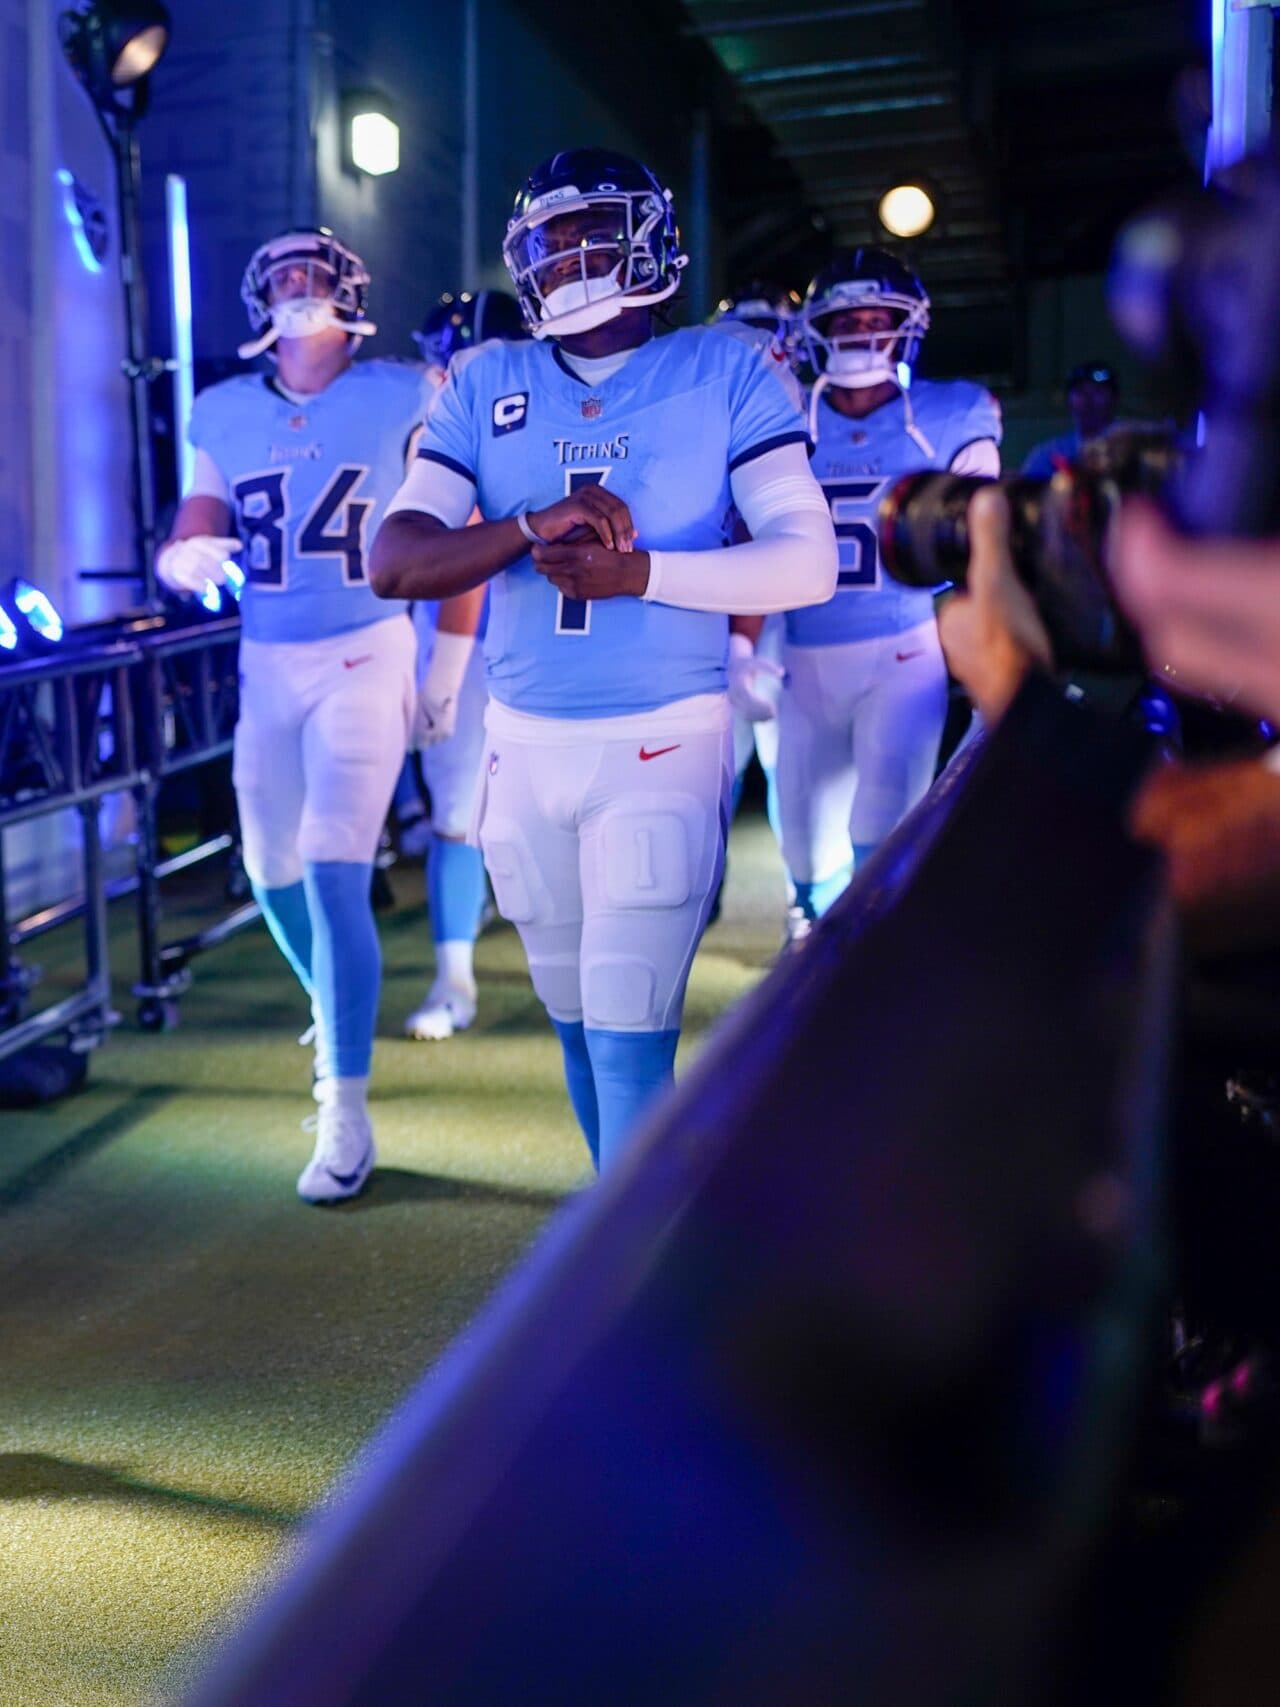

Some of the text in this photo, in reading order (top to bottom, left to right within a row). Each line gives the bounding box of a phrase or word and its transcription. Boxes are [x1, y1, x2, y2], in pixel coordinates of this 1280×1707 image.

[494, 394, 526, 427] C
[554, 434, 629, 465] TITANS
[231, 463, 376, 592] 84
